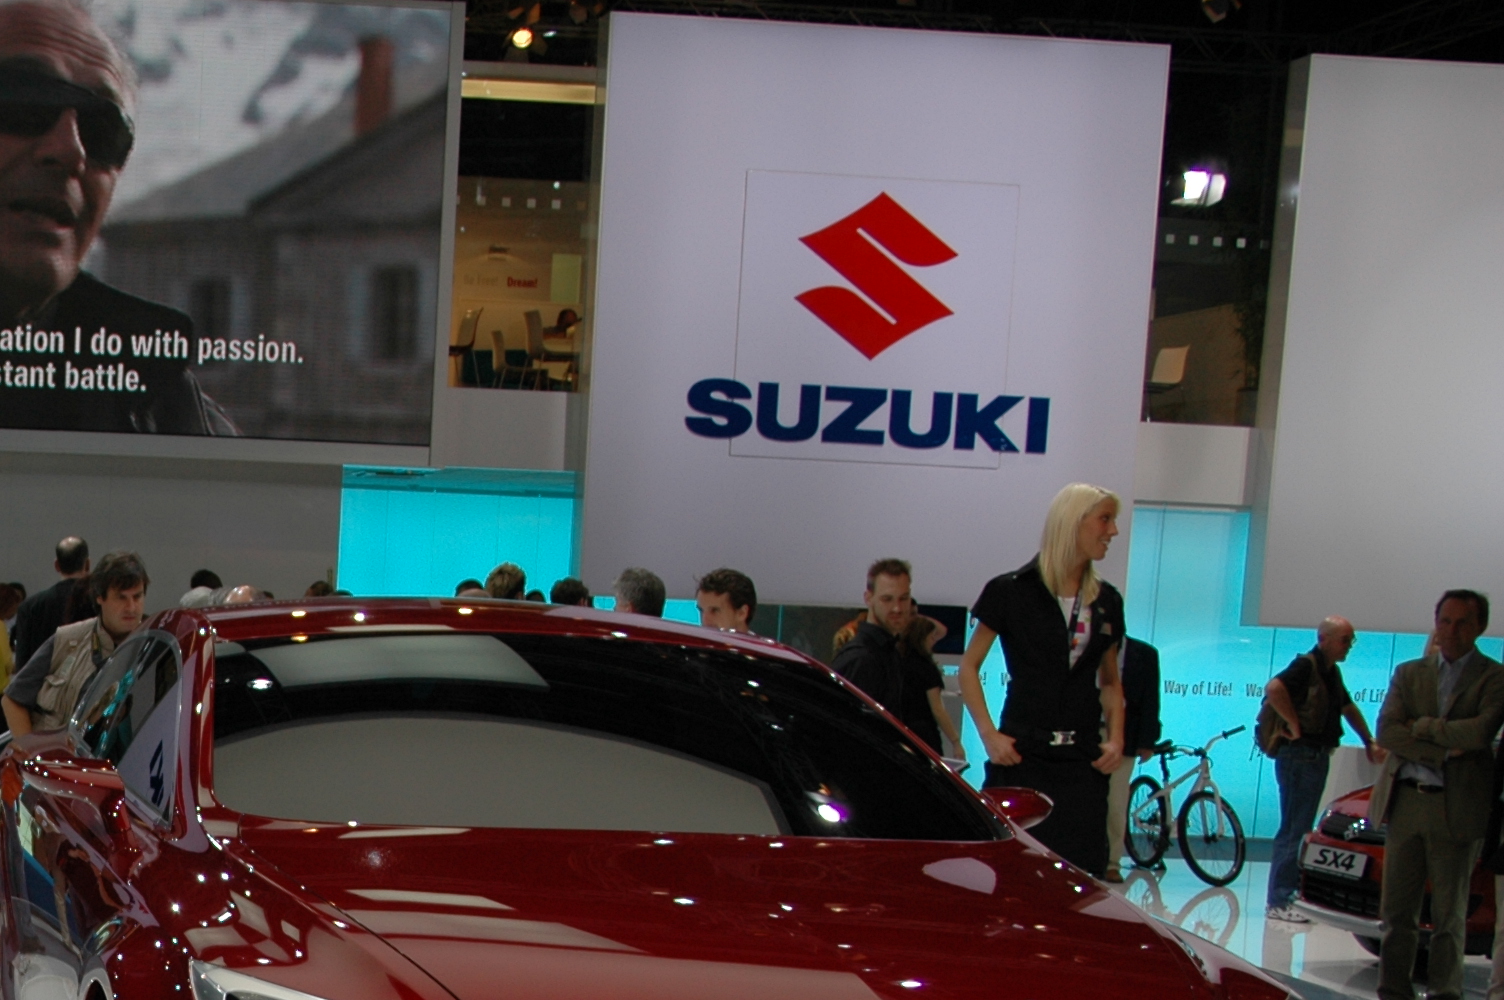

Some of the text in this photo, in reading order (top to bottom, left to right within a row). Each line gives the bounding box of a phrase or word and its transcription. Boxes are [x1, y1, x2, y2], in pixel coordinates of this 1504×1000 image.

[74, 326, 82, 355] I
[91, 326, 123, 356] do
[131, 328, 189, 359] with
[198, 333, 304, 365] passion.
[64, 360, 147, 393] battle.
[683, 377, 1052, 456] SUZUKI
[1164, 680, 1189, 698] Way
[1192, 681, 1206, 695] of
[1207, 681, 1233, 697] Life!
[1245, 683, 1264, 698] Wa
[1354, 687, 1367, 703] of
[1313, 848, 1357, 872] SX4
